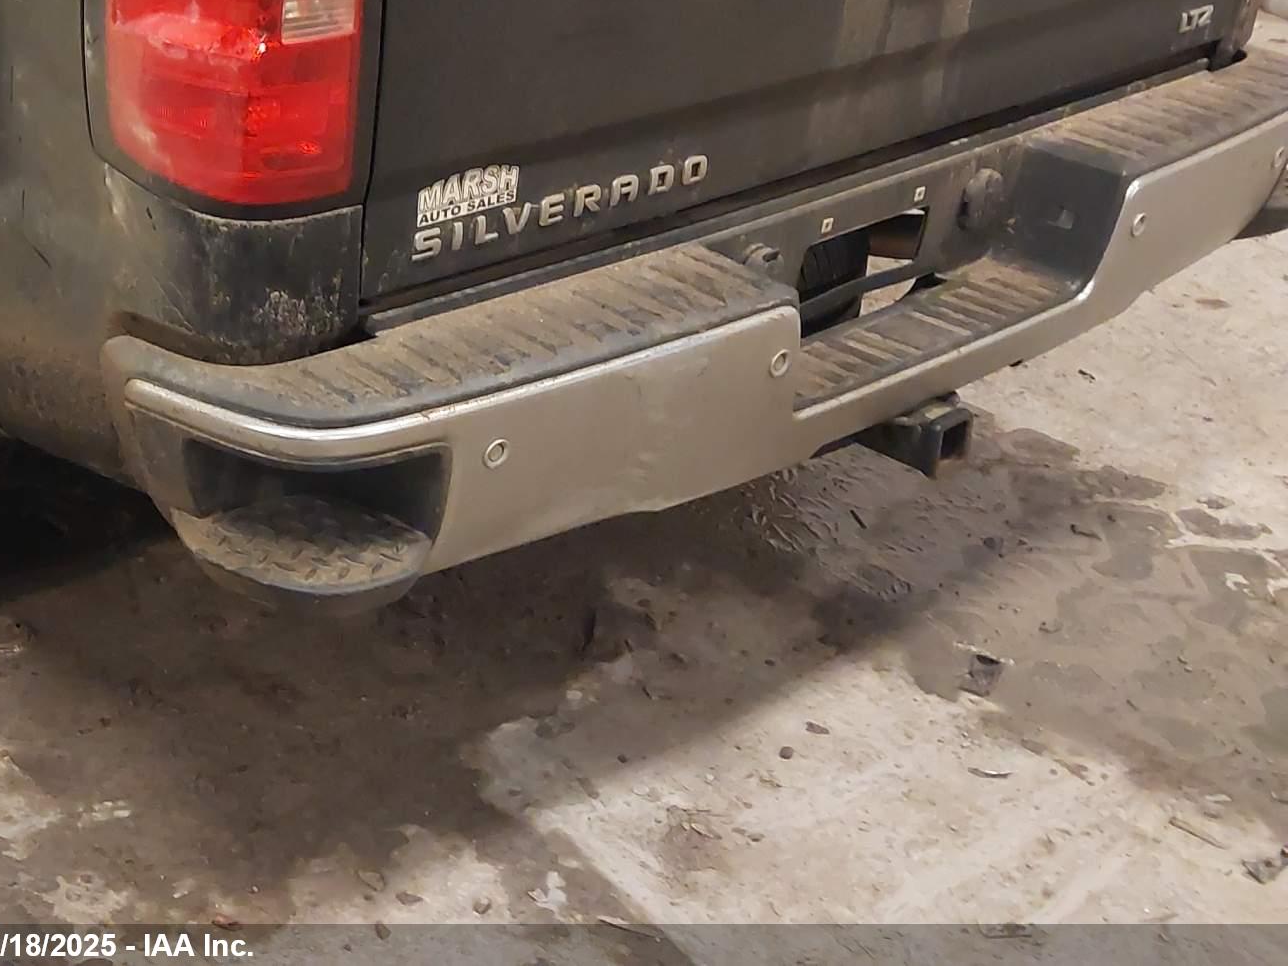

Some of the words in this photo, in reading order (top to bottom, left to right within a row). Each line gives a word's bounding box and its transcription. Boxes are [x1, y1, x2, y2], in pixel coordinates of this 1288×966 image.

[1178, 4, 1214, 34] LTZ
[412, 155, 709, 261] SILVERADO
[417, 164, 520, 212] MARSH
[419, 205, 462, 225] AUTO
[467, 190, 515, 212] SALES
